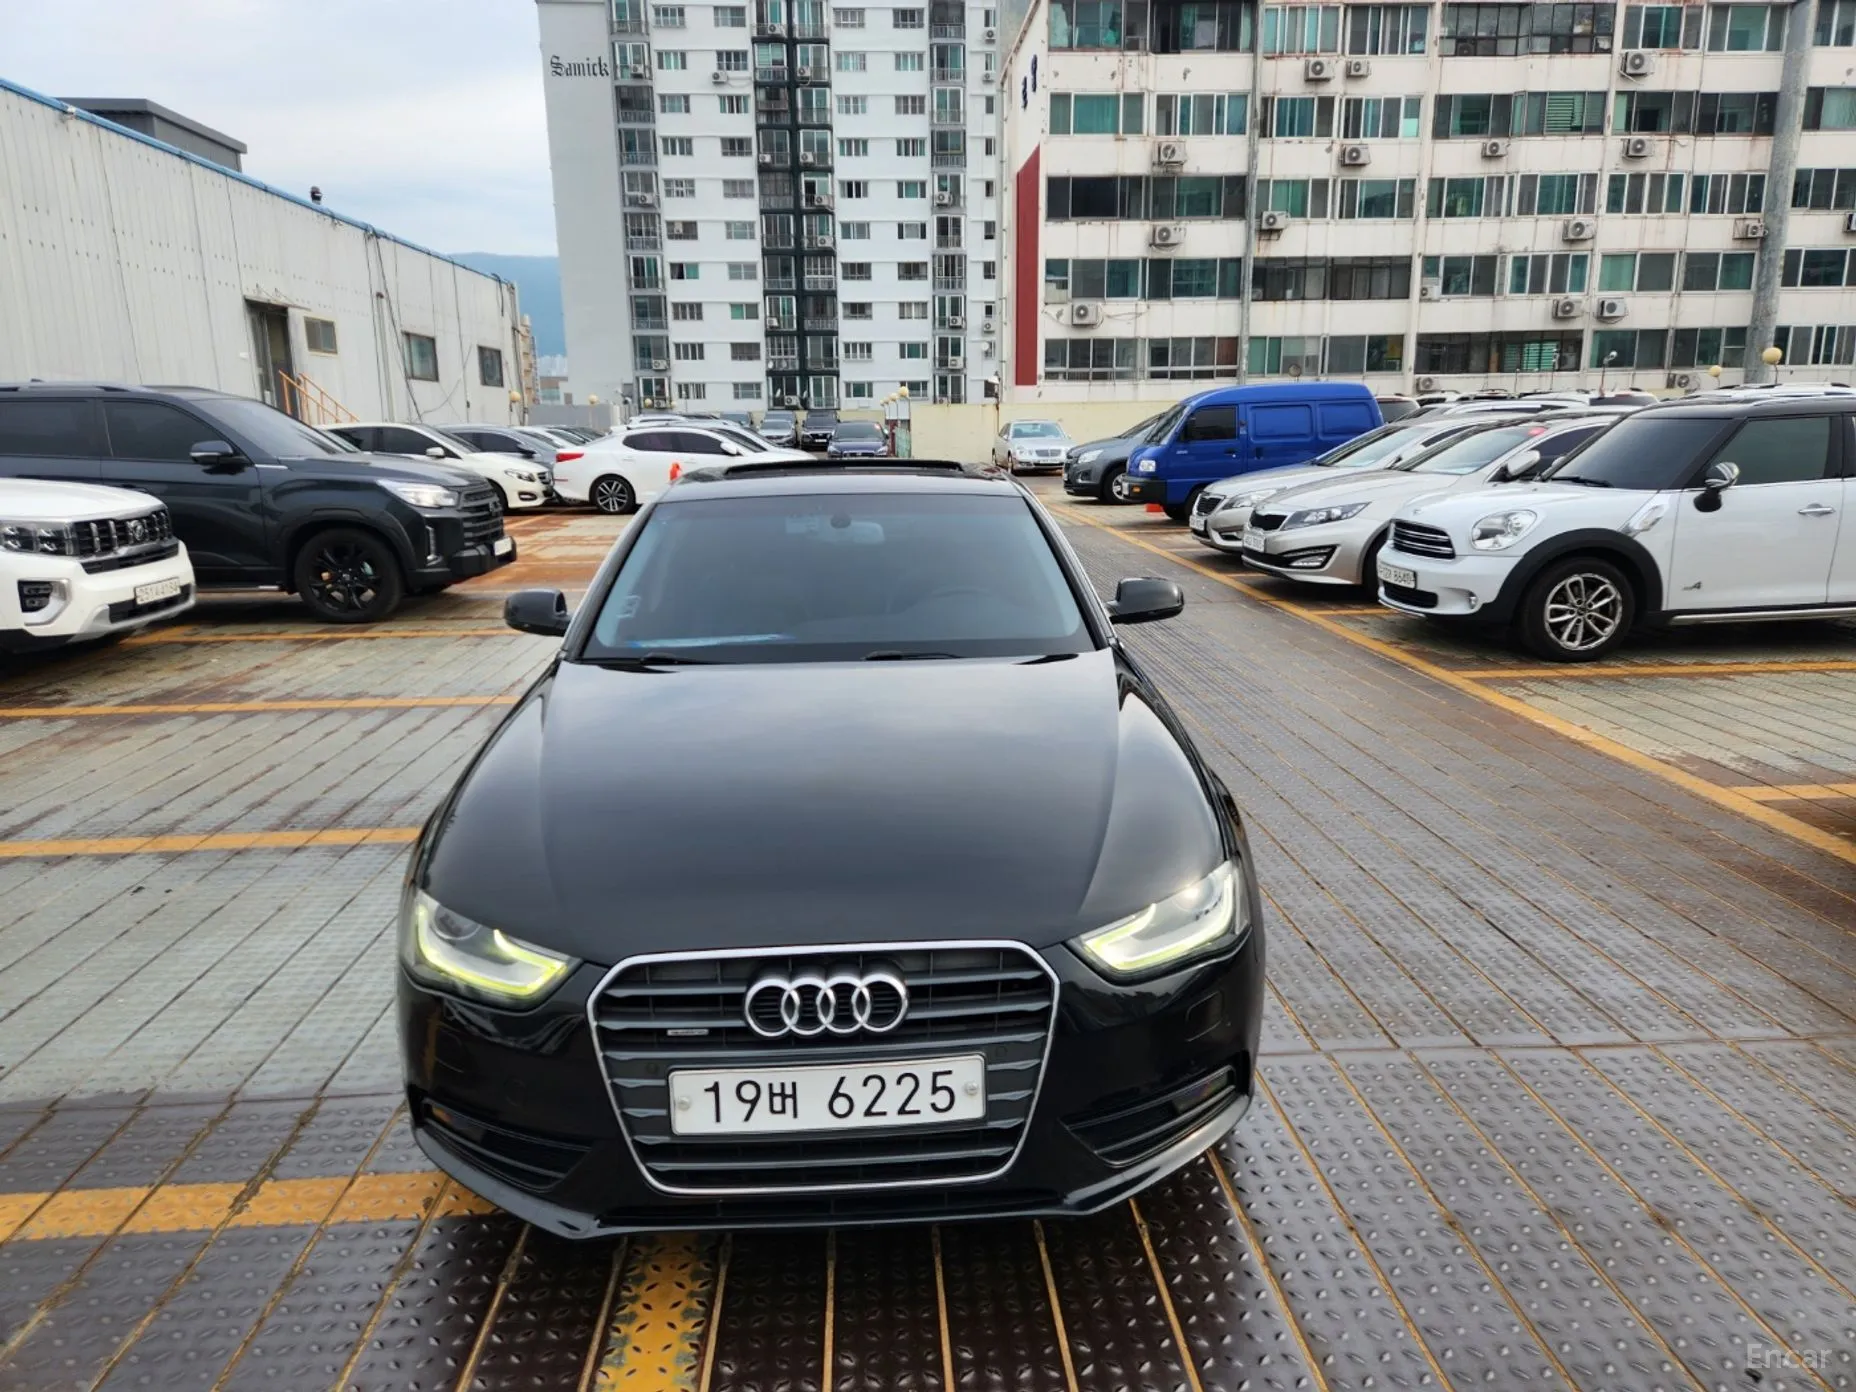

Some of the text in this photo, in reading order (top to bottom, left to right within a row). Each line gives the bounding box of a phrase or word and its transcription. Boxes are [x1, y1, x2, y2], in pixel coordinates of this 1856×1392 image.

[550, 55, 609, 77] Samick
[704, 1070, 956, 1122] 19버 6225
